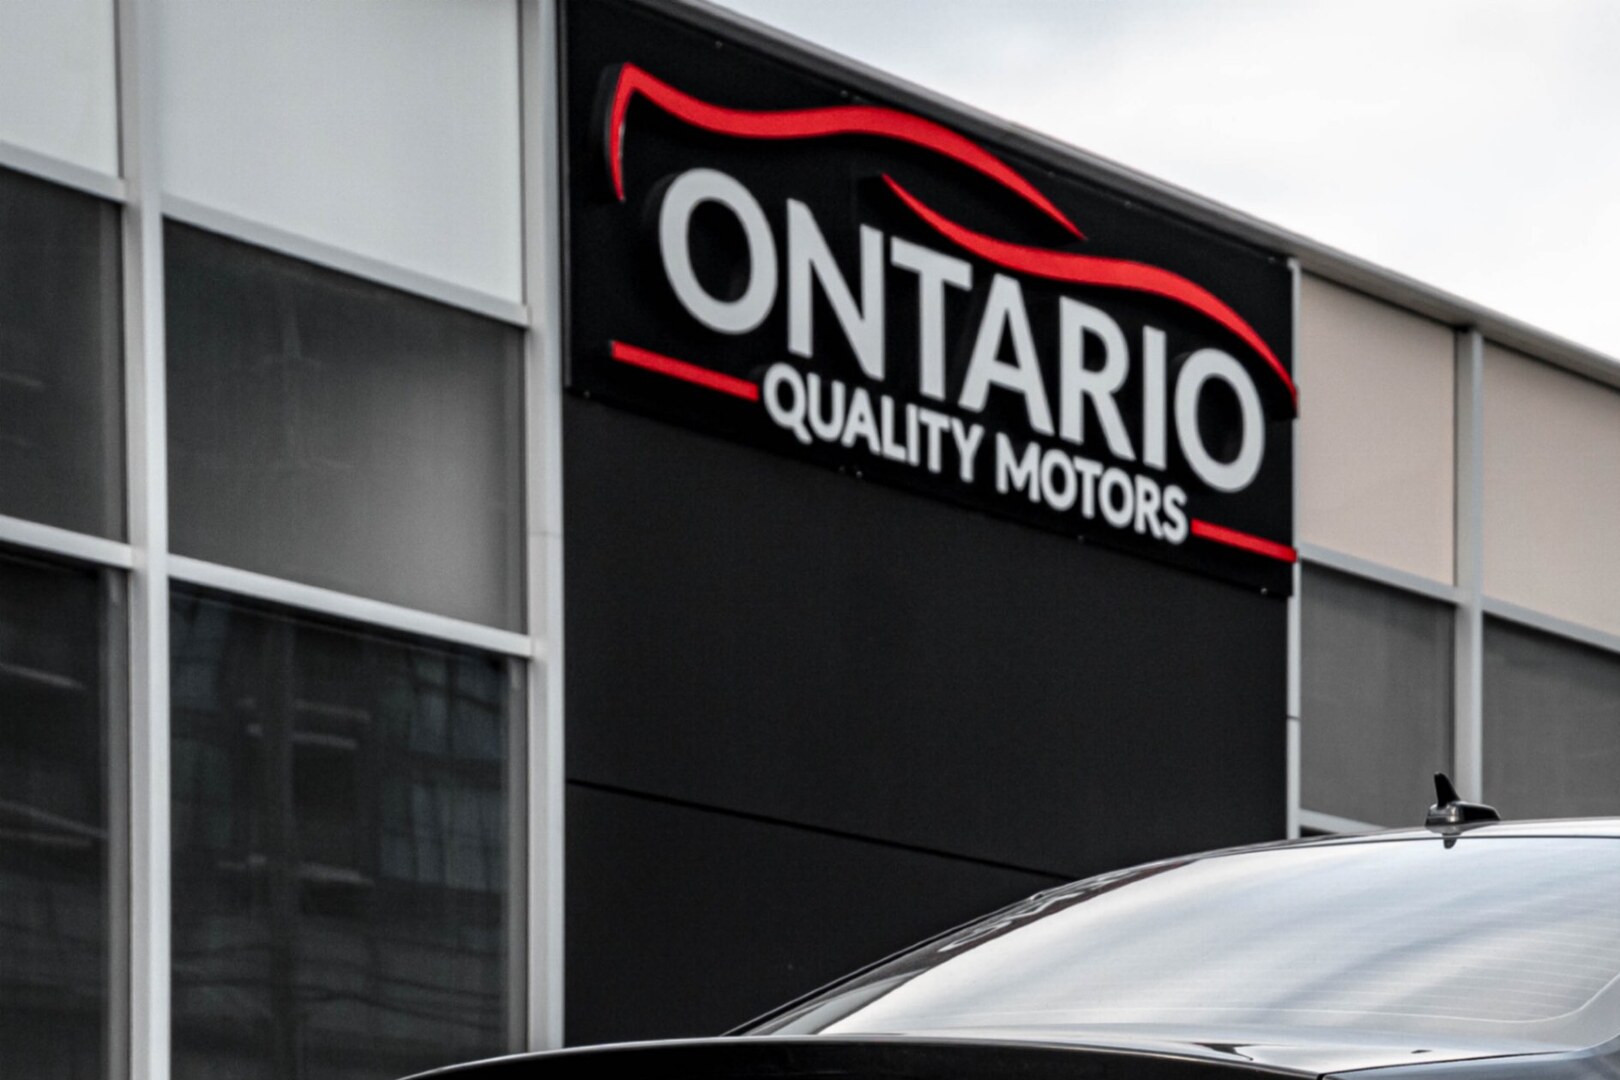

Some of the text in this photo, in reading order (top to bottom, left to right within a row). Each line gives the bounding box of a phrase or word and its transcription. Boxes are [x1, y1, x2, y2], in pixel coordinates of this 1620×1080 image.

[659, 167, 1266, 493] ONTARIO
[763, 362, 1189, 544] QUALITY MOTORS
